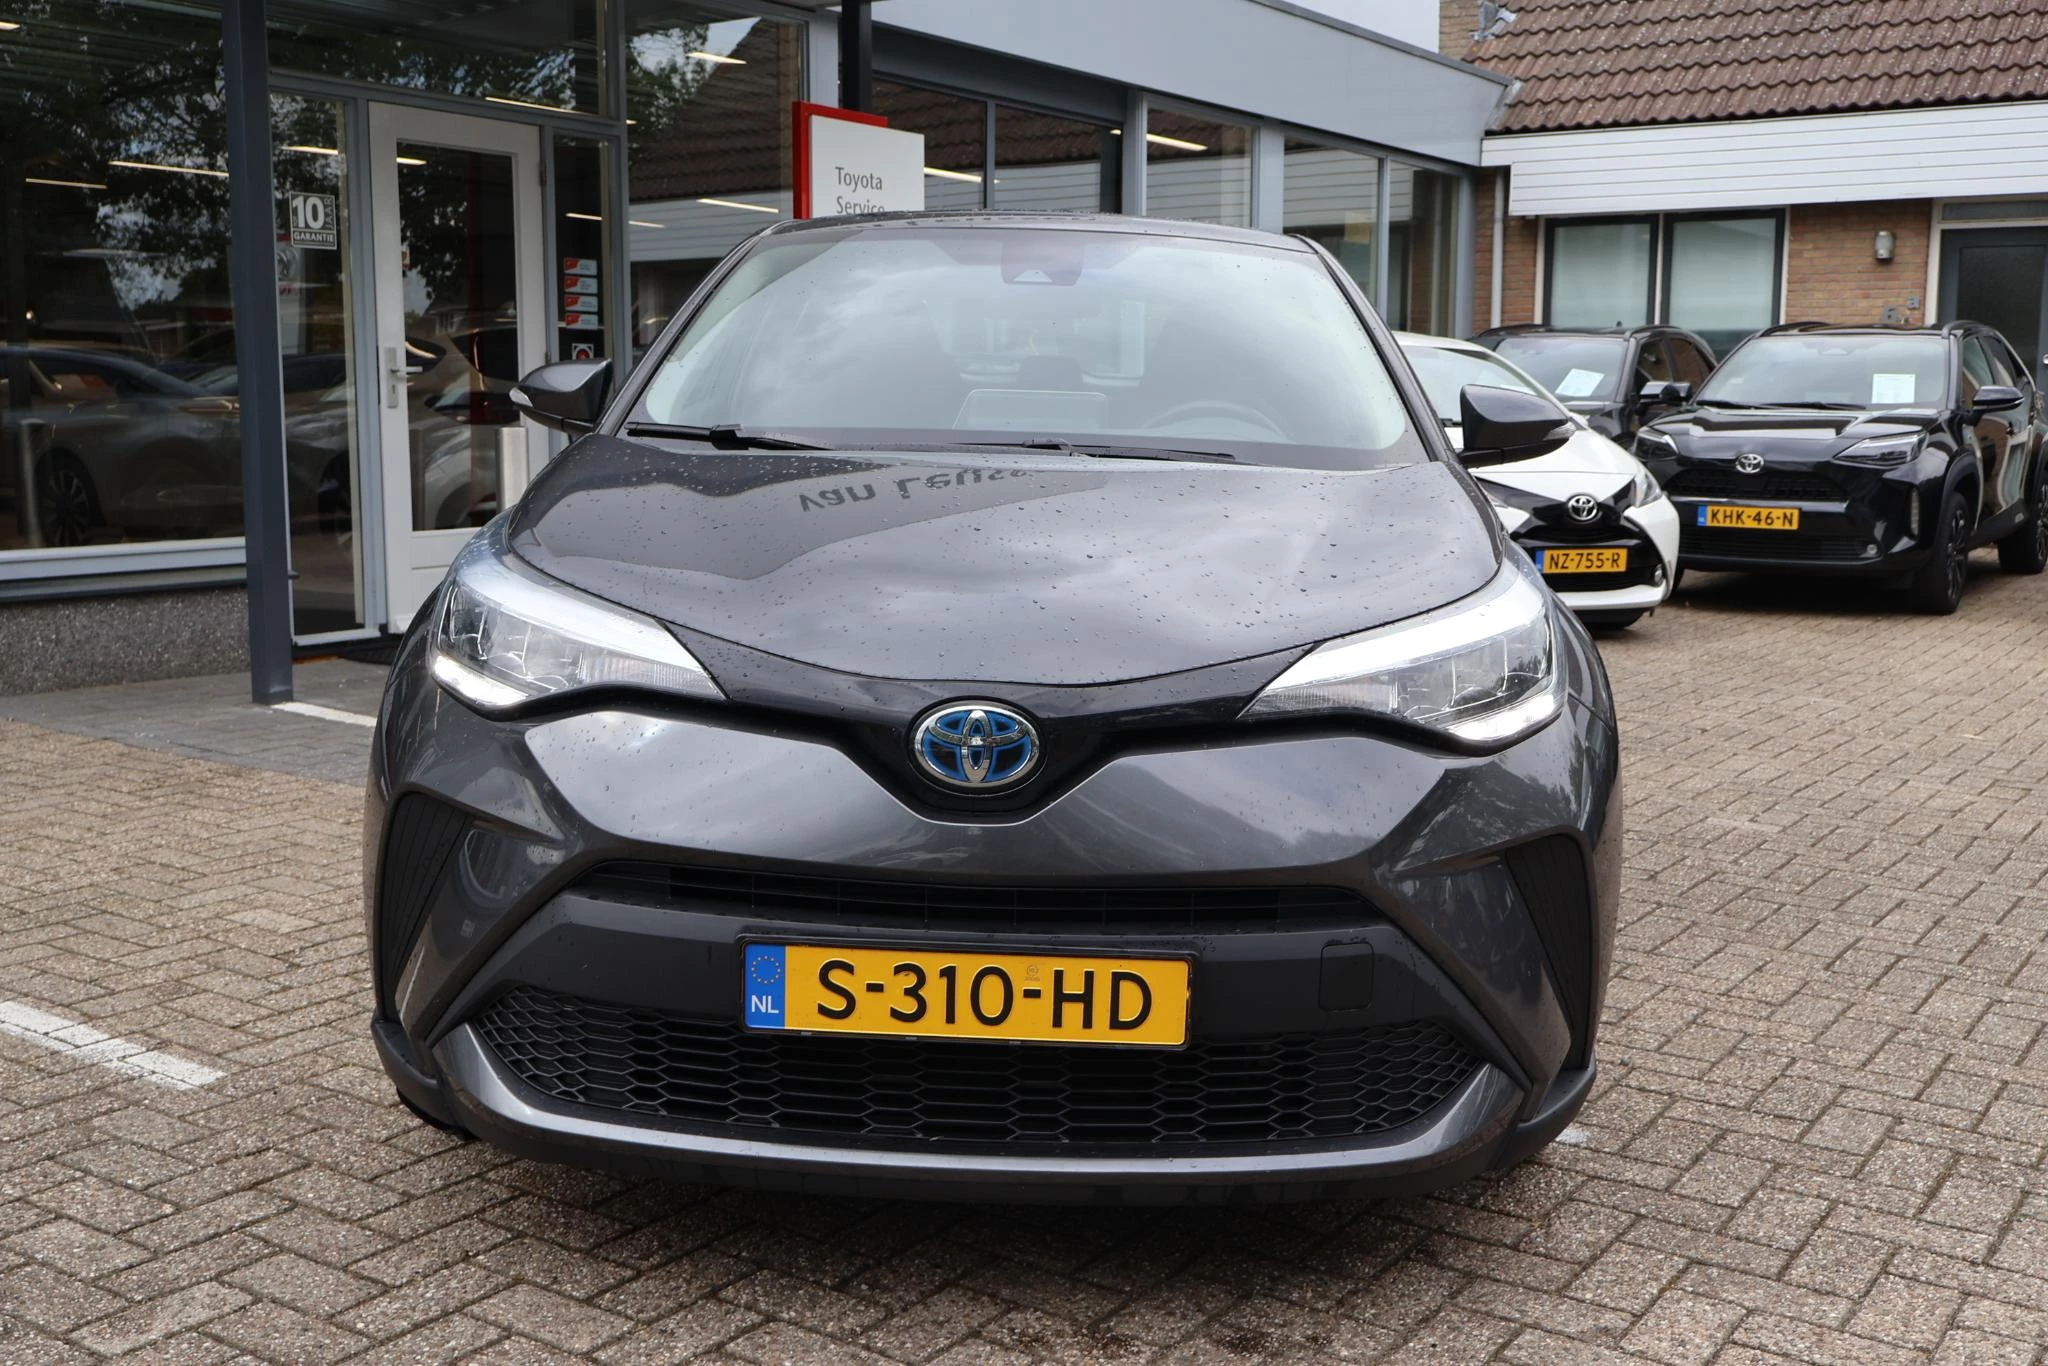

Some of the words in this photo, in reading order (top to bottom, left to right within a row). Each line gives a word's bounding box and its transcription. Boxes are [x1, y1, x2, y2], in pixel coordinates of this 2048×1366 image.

[834, 166, 883, 193] Toyota
[292, 196, 325, 229] 10
[324, 198, 333, 230] JAAR
[293, 231, 335, 242] GARANTIE
[1710, 508, 1794, 527] KHK-46-N
[1549, 552, 1621, 570] NZ-755-R
[751, 994, 780, 1015] NL
[816, 958, 1153, 1031] S-310-HD
